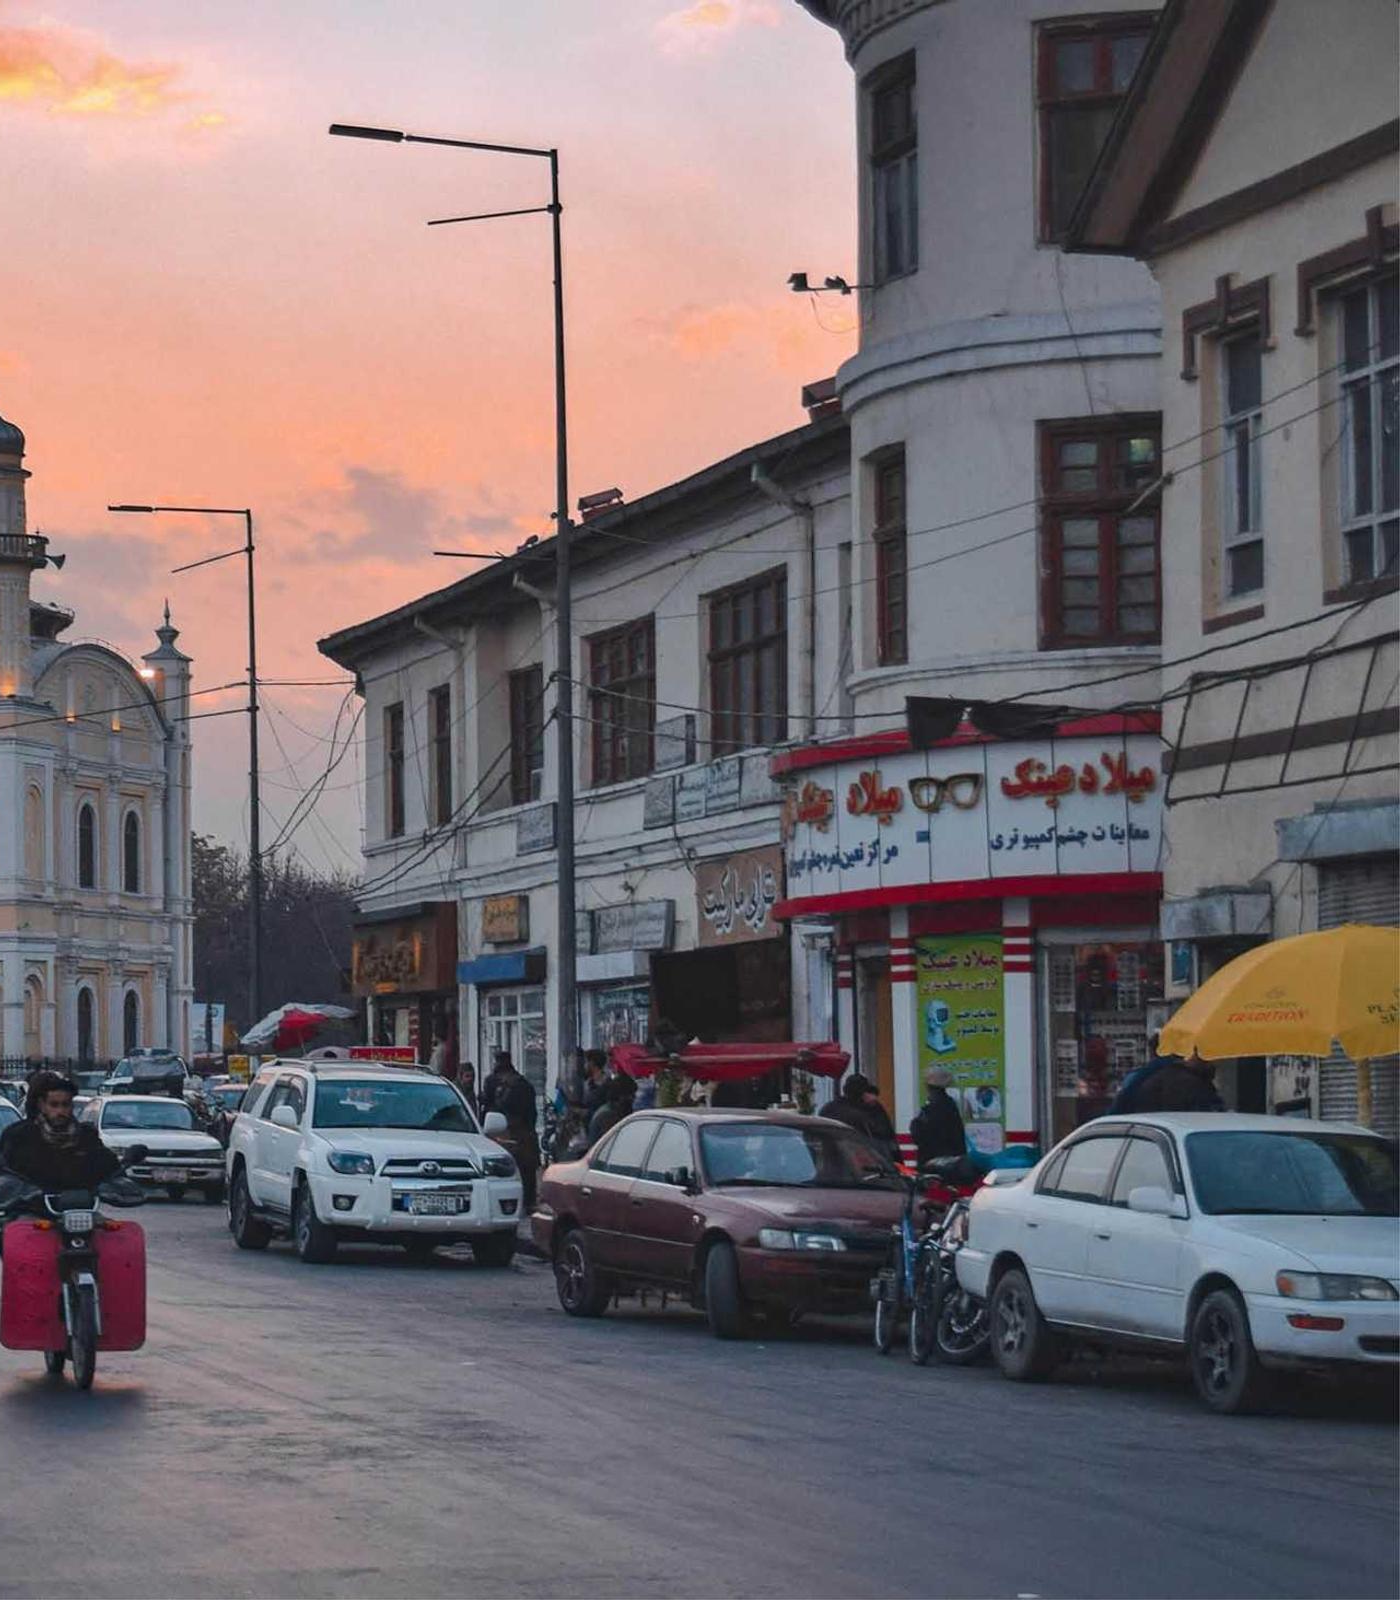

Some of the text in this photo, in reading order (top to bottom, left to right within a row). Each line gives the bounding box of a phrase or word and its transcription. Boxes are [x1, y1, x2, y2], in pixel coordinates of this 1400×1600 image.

[846, 769, 903, 827] میلاد
[1001, 752, 1156, 809] میلاد عینک
